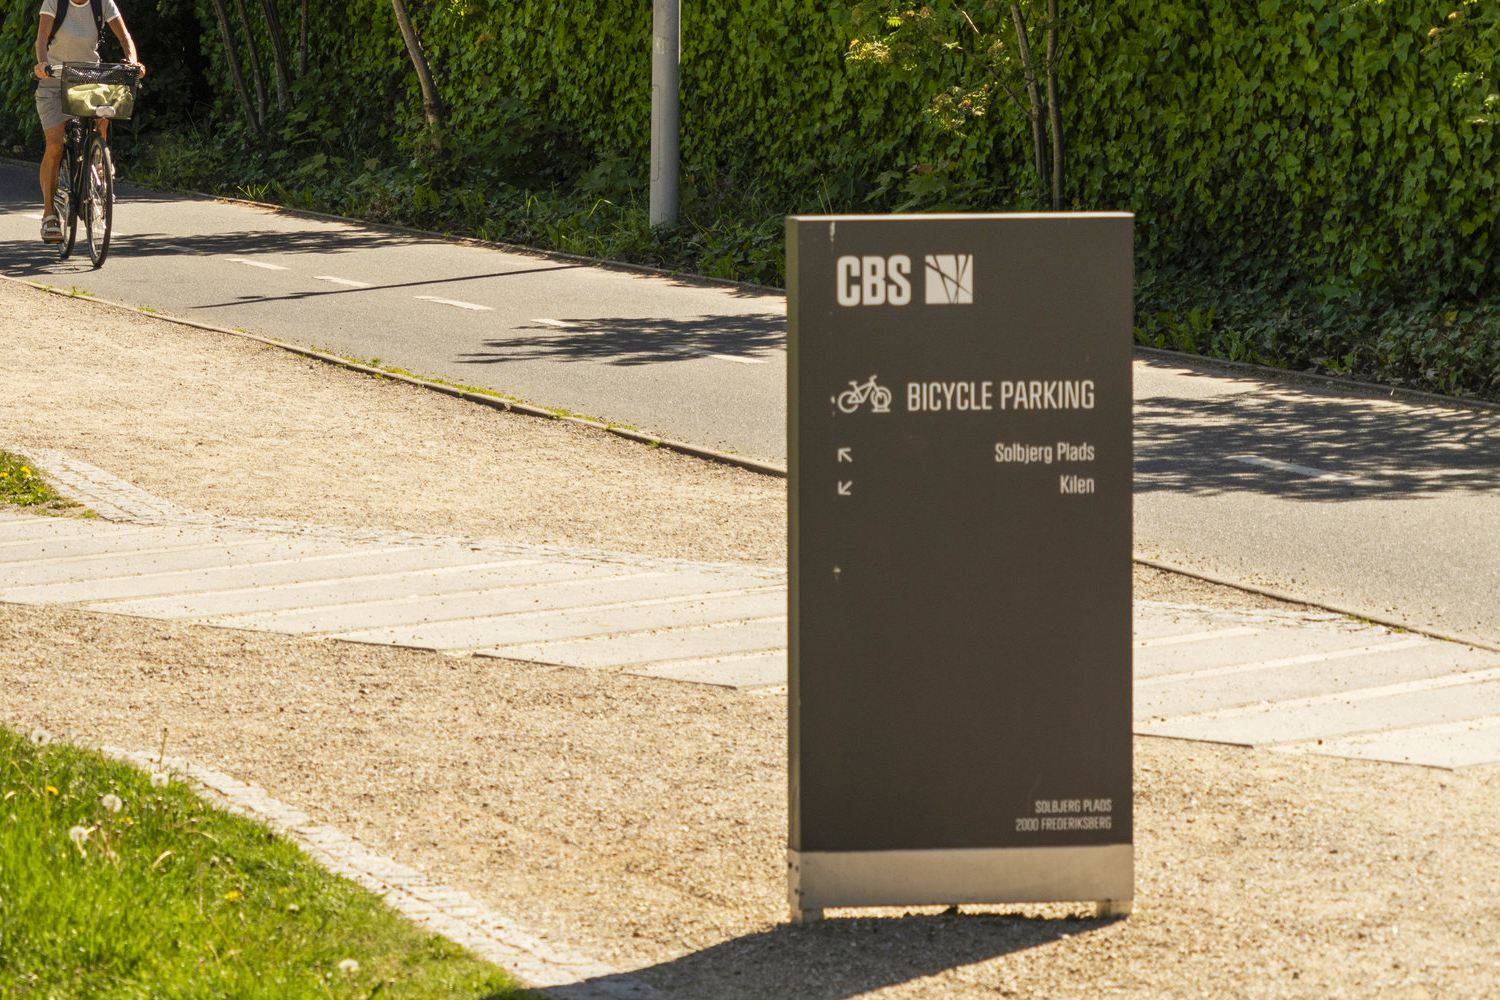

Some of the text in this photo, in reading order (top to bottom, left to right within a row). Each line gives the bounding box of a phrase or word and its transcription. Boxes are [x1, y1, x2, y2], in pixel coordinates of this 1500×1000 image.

[836, 254, 912, 307] CBS
[907, 379, 1095, 412] BICYCLE PARKING
[994, 441, 1095, 465] Solbjerg Plads
[1059, 474, 1095, 494] Kilen
[1035, 798, 1112, 814] SOLBJERG PLADS
[1015, 816, 1112, 831] 2000 FREDERIKSBERG
